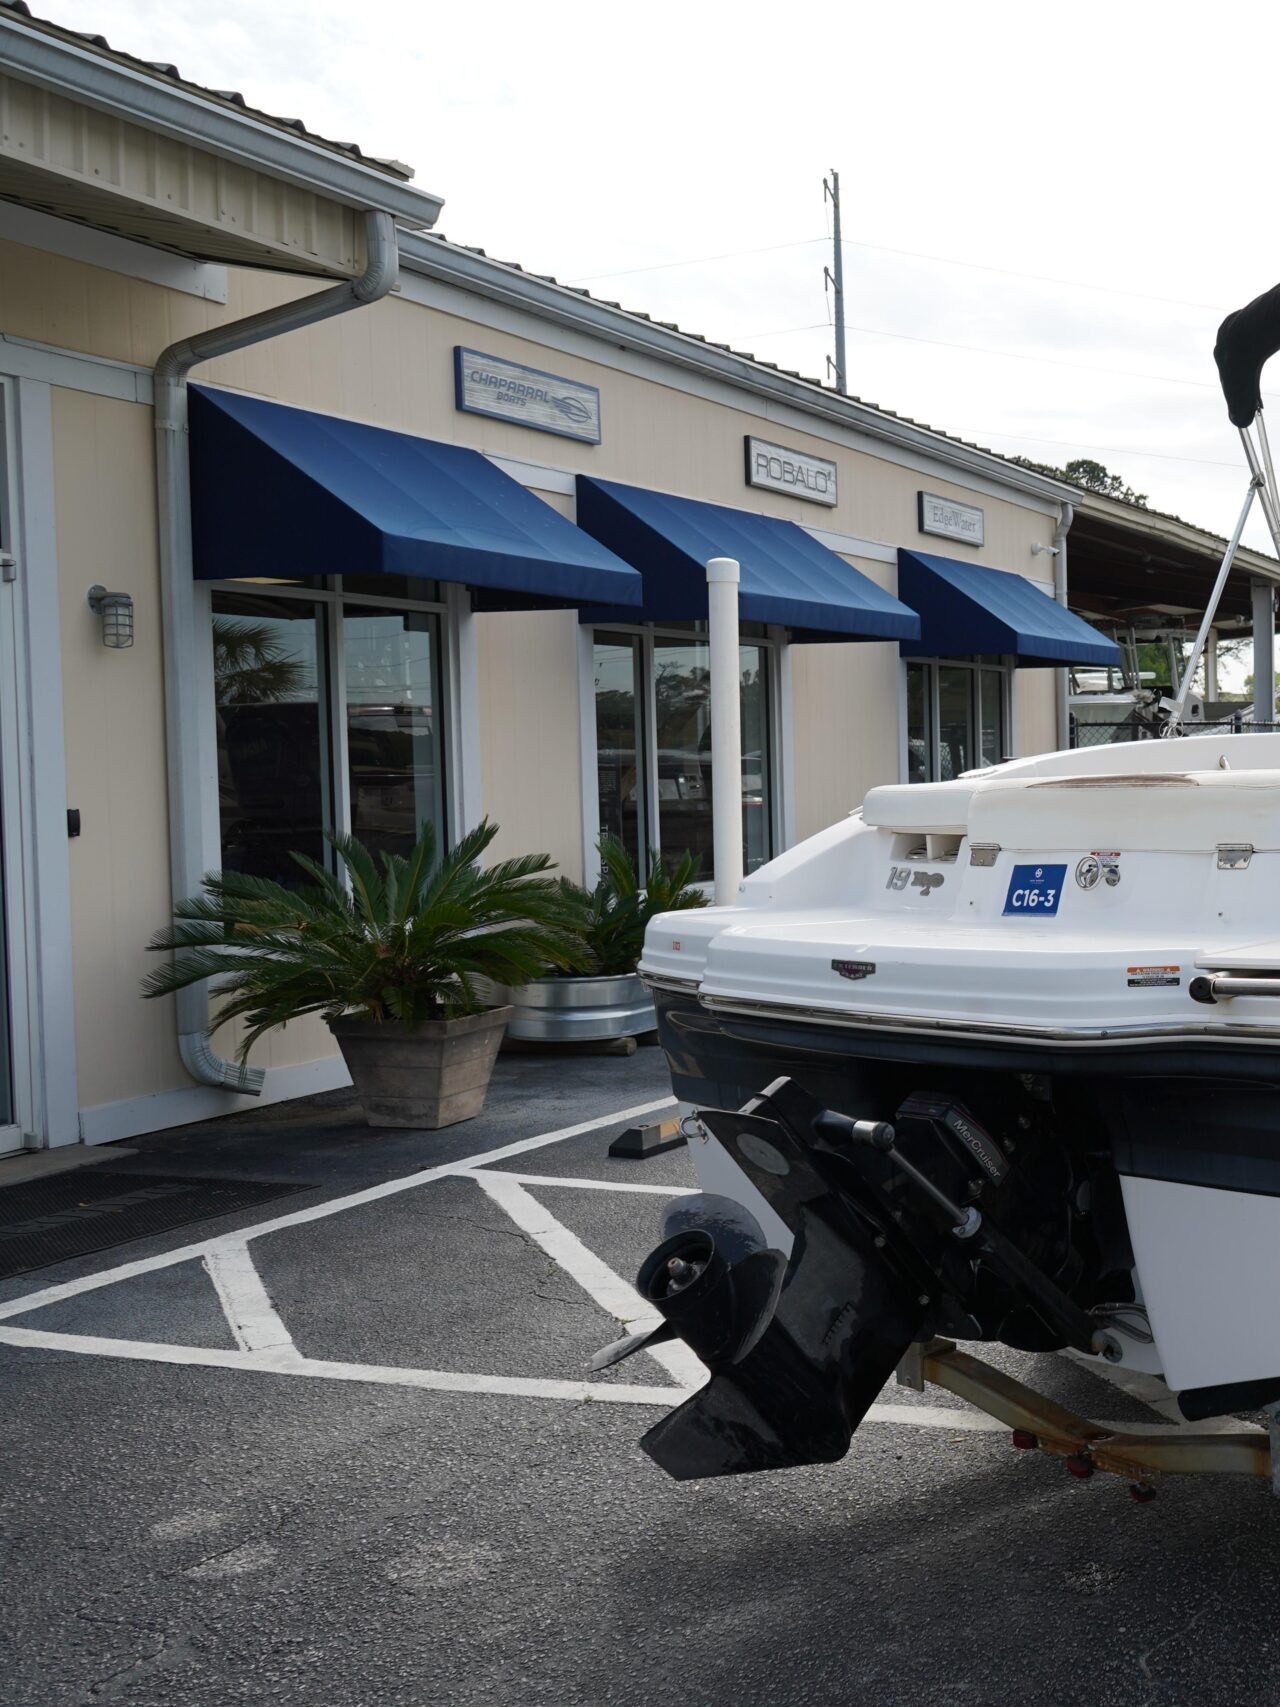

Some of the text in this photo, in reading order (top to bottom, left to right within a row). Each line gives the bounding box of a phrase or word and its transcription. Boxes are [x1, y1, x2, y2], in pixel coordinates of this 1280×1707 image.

[470, 370, 549, 403] CHAPARRAL
[496, 391, 527, 407] BOATS
[756, 453, 828, 493] ROBALO
[932, 504, 977, 533] EdgeWater
[885, 866, 911, 890] 19
[1012, 889, 1056, 908] C16-3
[953, 1119, 1001, 1177] MerCruiser
